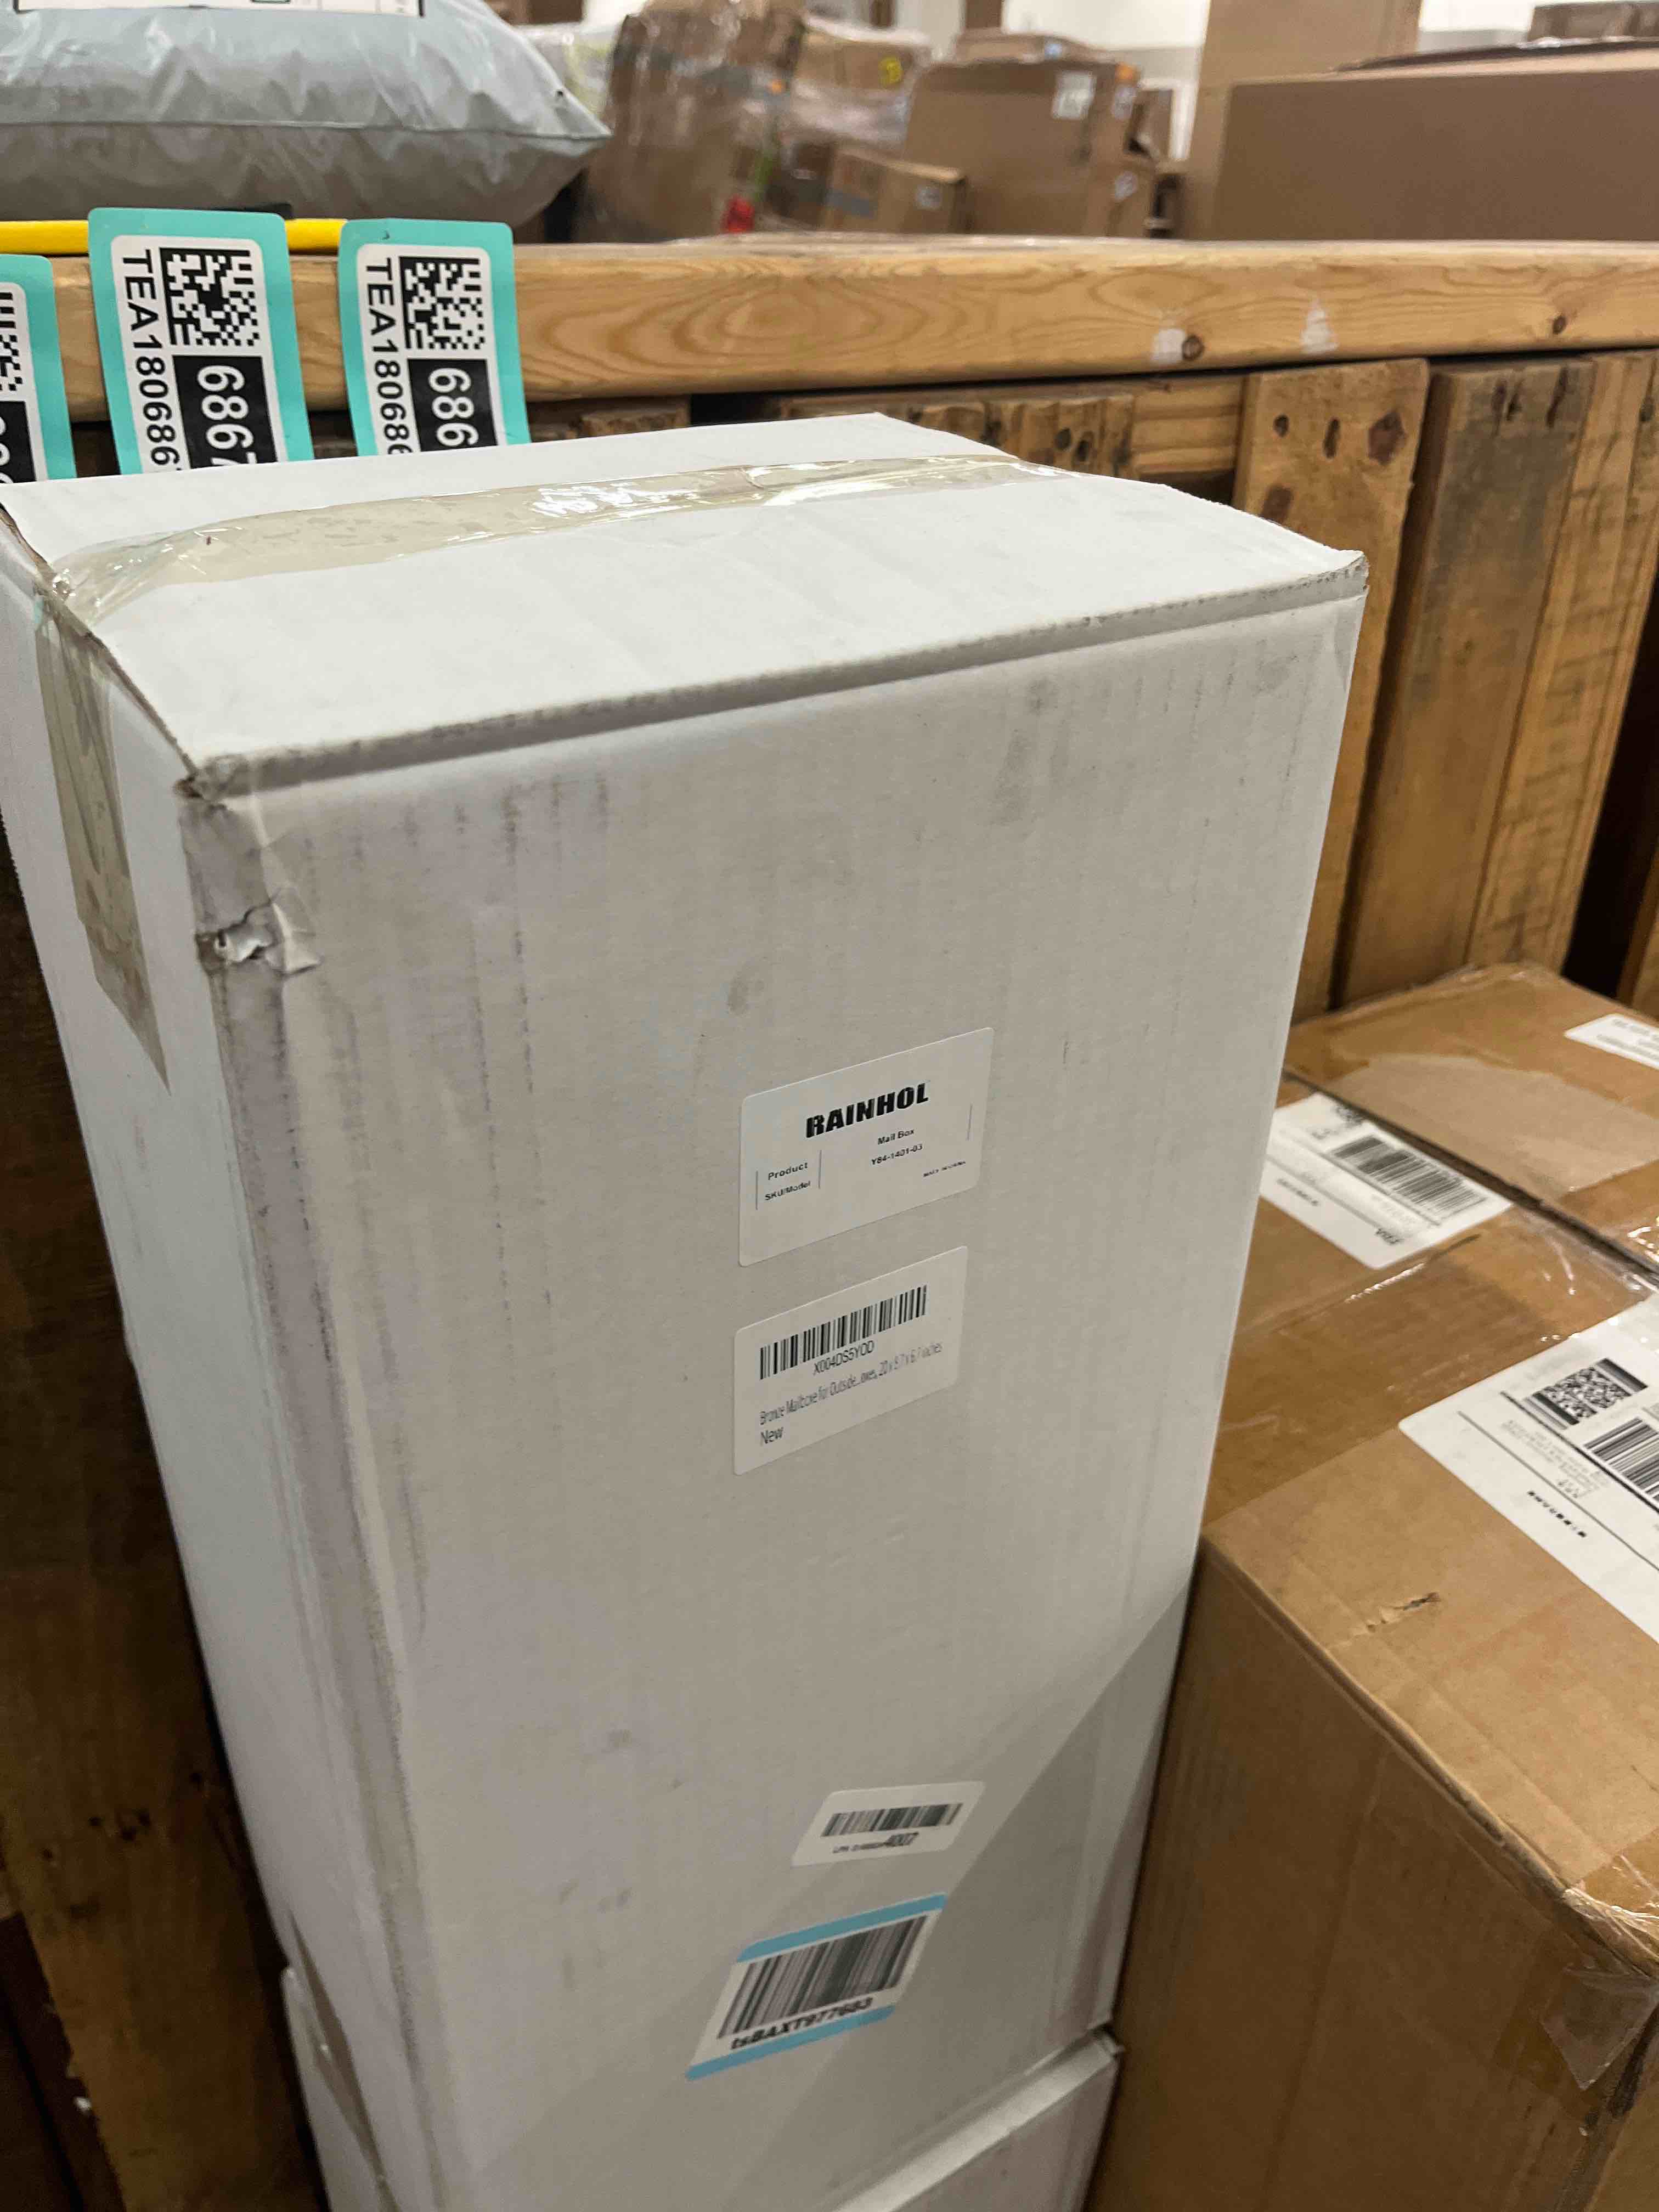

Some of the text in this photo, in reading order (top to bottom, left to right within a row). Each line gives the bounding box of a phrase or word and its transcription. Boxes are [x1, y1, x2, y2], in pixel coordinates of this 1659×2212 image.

[122, 249, 182, 471] TEA180686
[428, 367, 479, 447] 686
[806, 1083, 929, 1138] RAINHOL
[878, 1130, 914, 1145] Mail Box
[768, 1163, 808, 1181] Product
[760, 1426, 785, 1446] New
